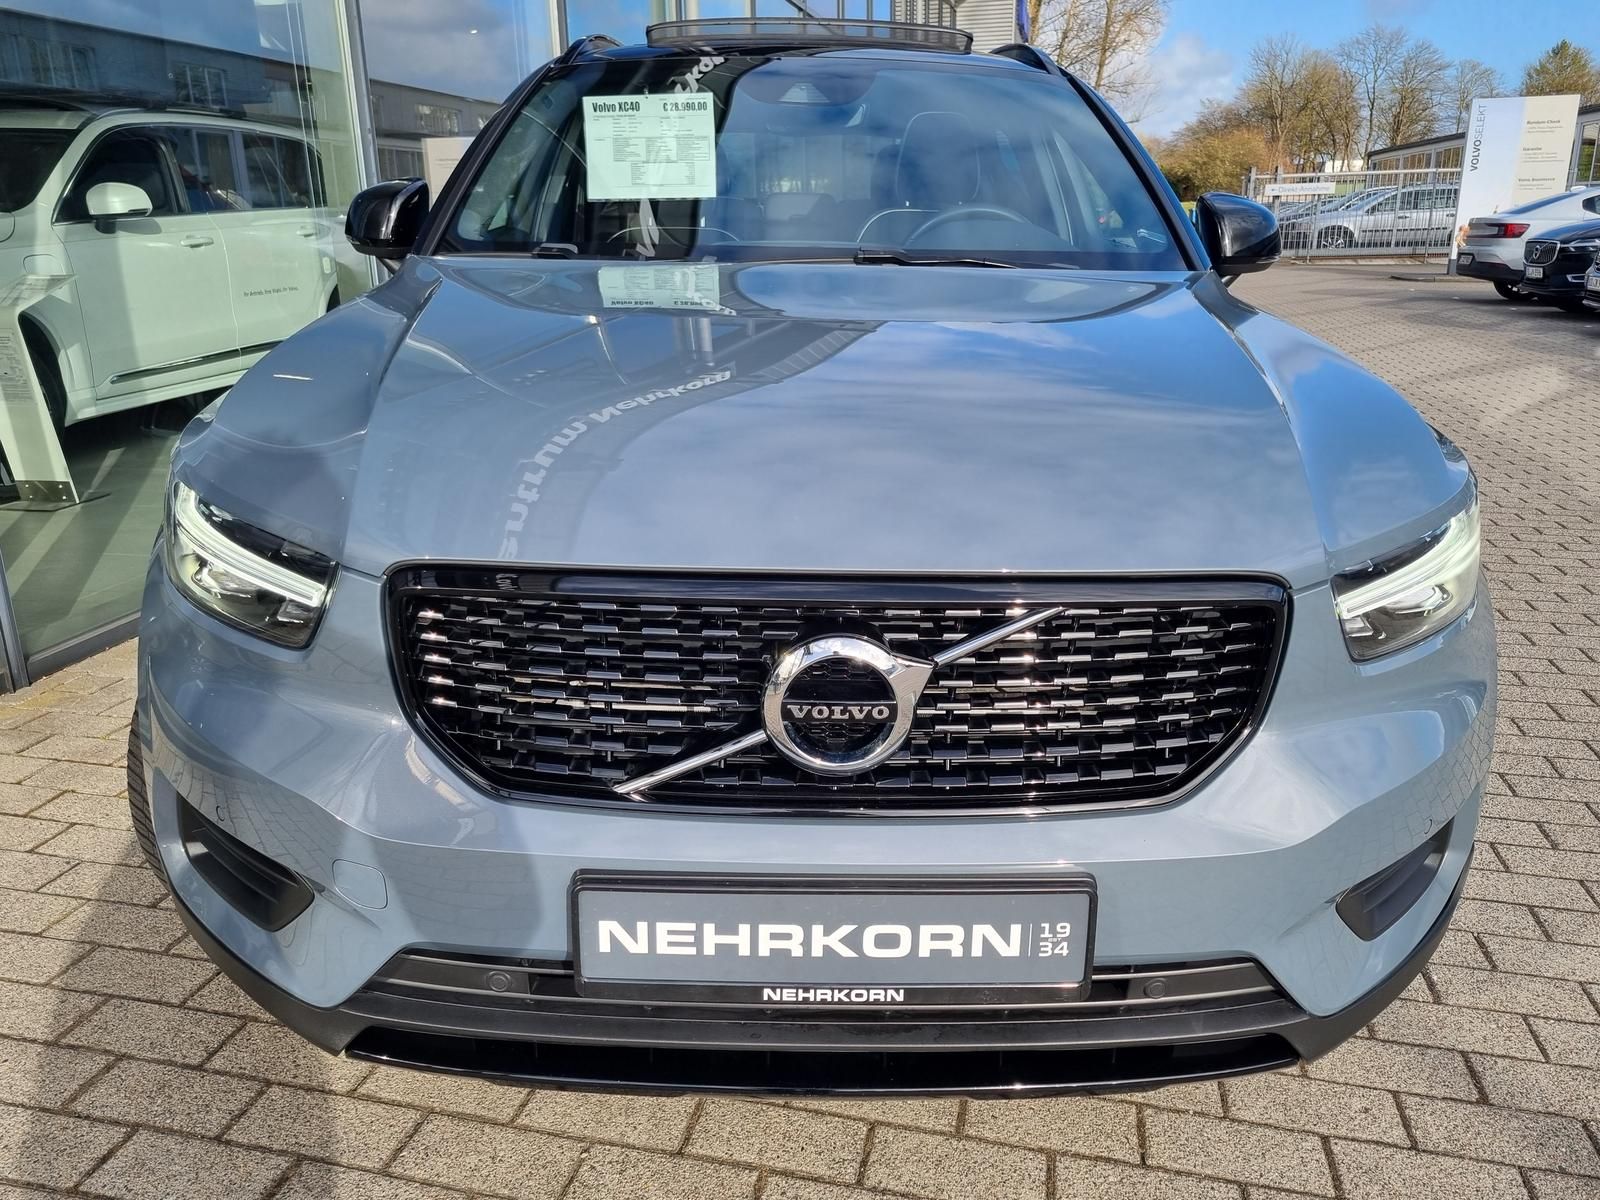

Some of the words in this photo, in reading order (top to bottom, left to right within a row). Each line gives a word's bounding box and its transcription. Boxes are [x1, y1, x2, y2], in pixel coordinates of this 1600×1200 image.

[592, 102, 616, 113] Volvo
[618, 101, 640, 112] XC40
[663, 102, 668, 112] €
[787, 705, 890, 720] VOLVO
[598, 920, 1022, 958] NEHRKORN
[1040, 922, 1071, 938] 19
[1039, 941, 1069, 957] 34
[762, 988, 905, 1002] NEHRKORN
